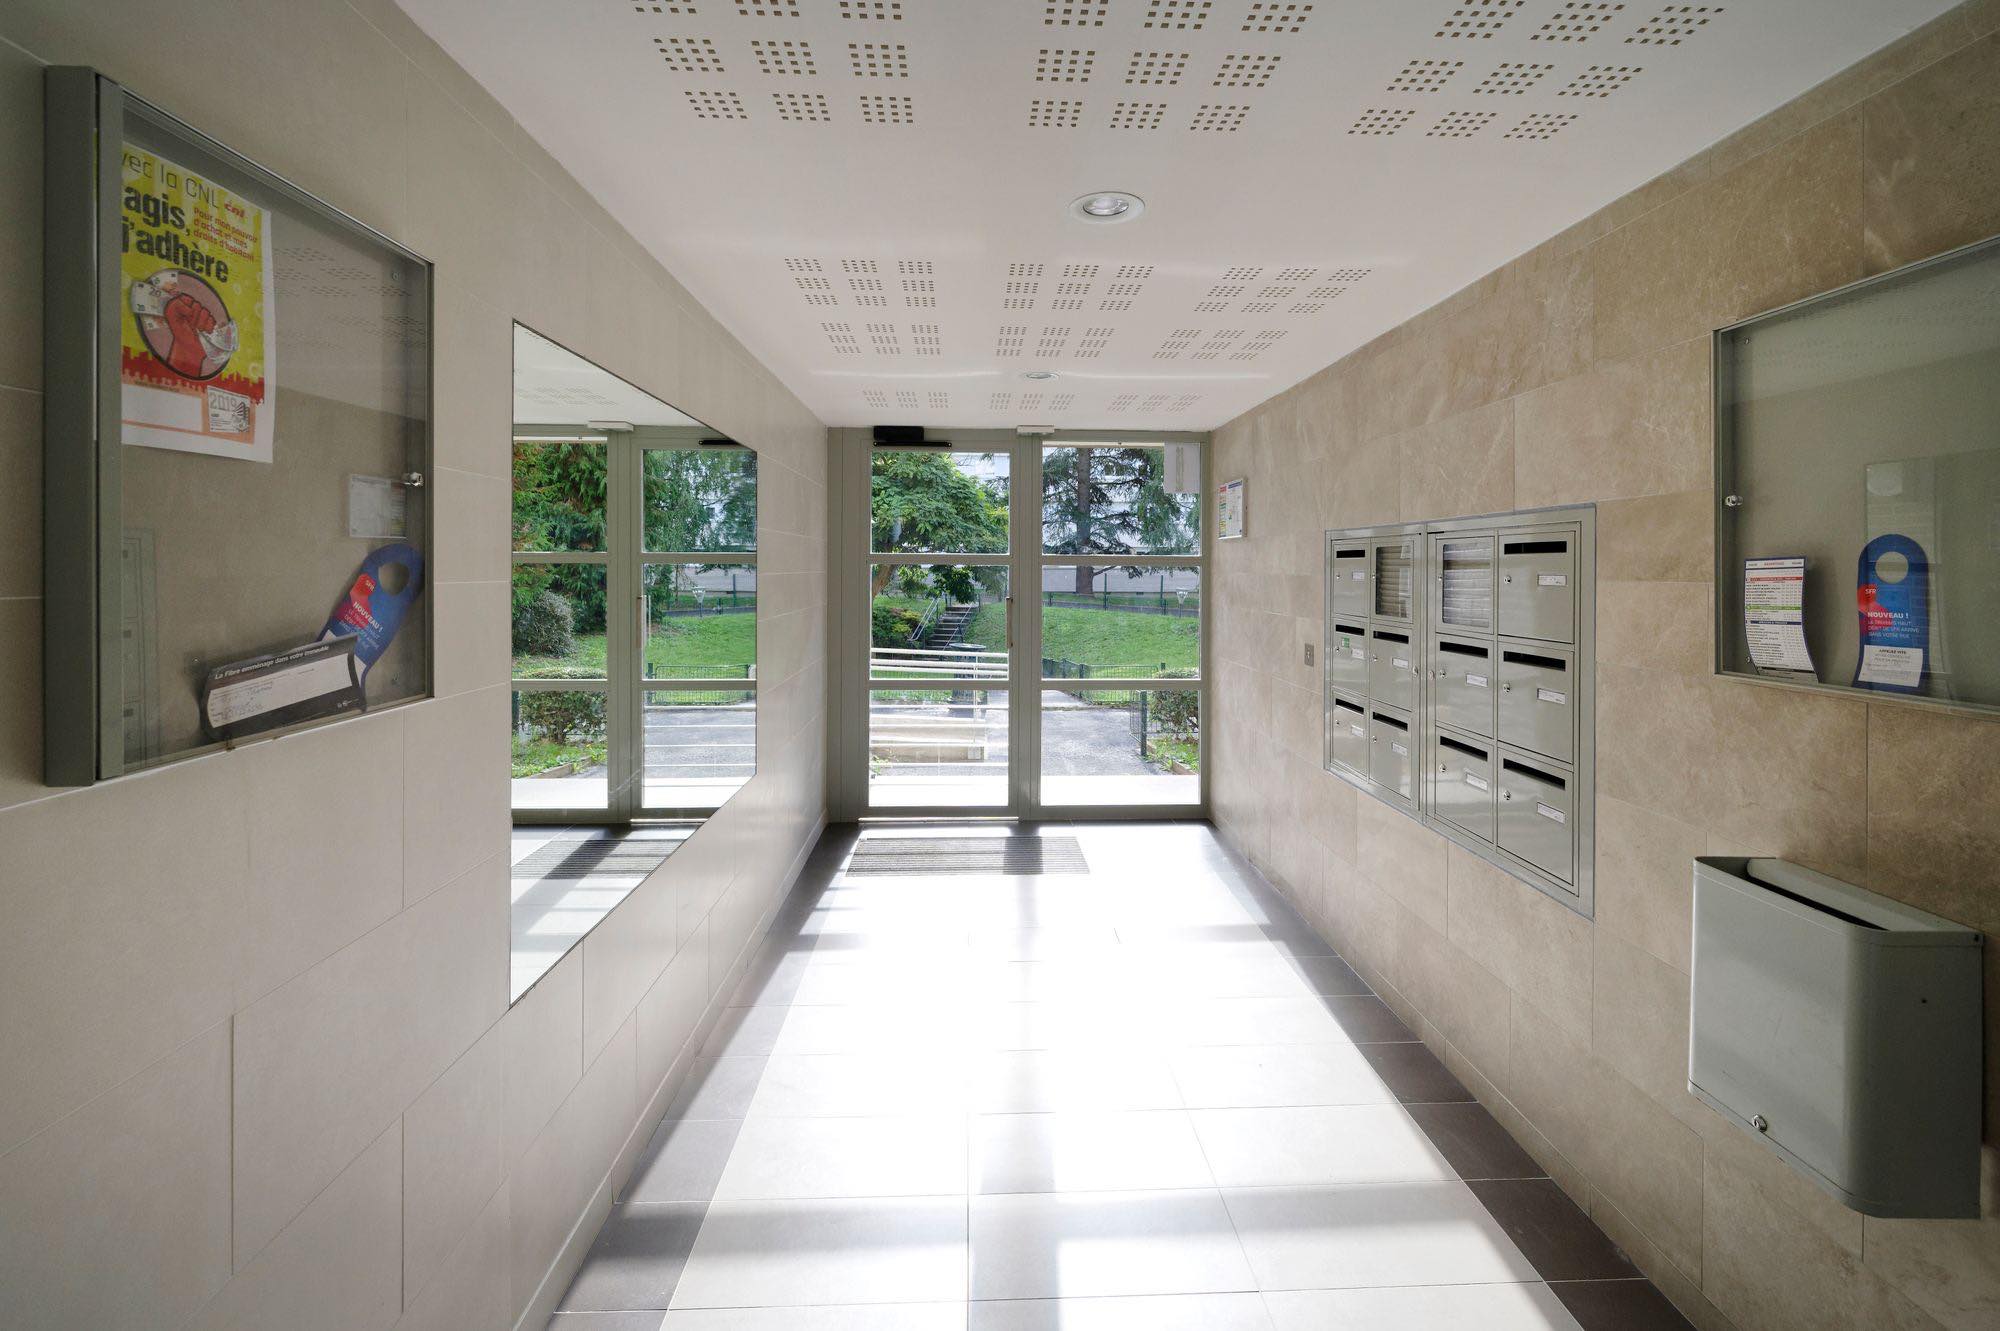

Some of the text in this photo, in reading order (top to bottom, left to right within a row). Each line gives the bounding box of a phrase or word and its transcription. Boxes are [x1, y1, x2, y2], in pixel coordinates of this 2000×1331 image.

[160, 164, 177, 189] la
[186, 177, 219, 209] CNL
[124, 186, 191, 237] agis,
[352, 601, 381, 630] NOUVEAU
[1867, 611, 1904, 619] NOUVEAU
[214, 672, 224, 681] La
[224, 667, 241, 679] Fibre
[241, 660, 275, 674] emménage
[275, 656, 289, 665] dans
[289, 651, 304, 660] votre
